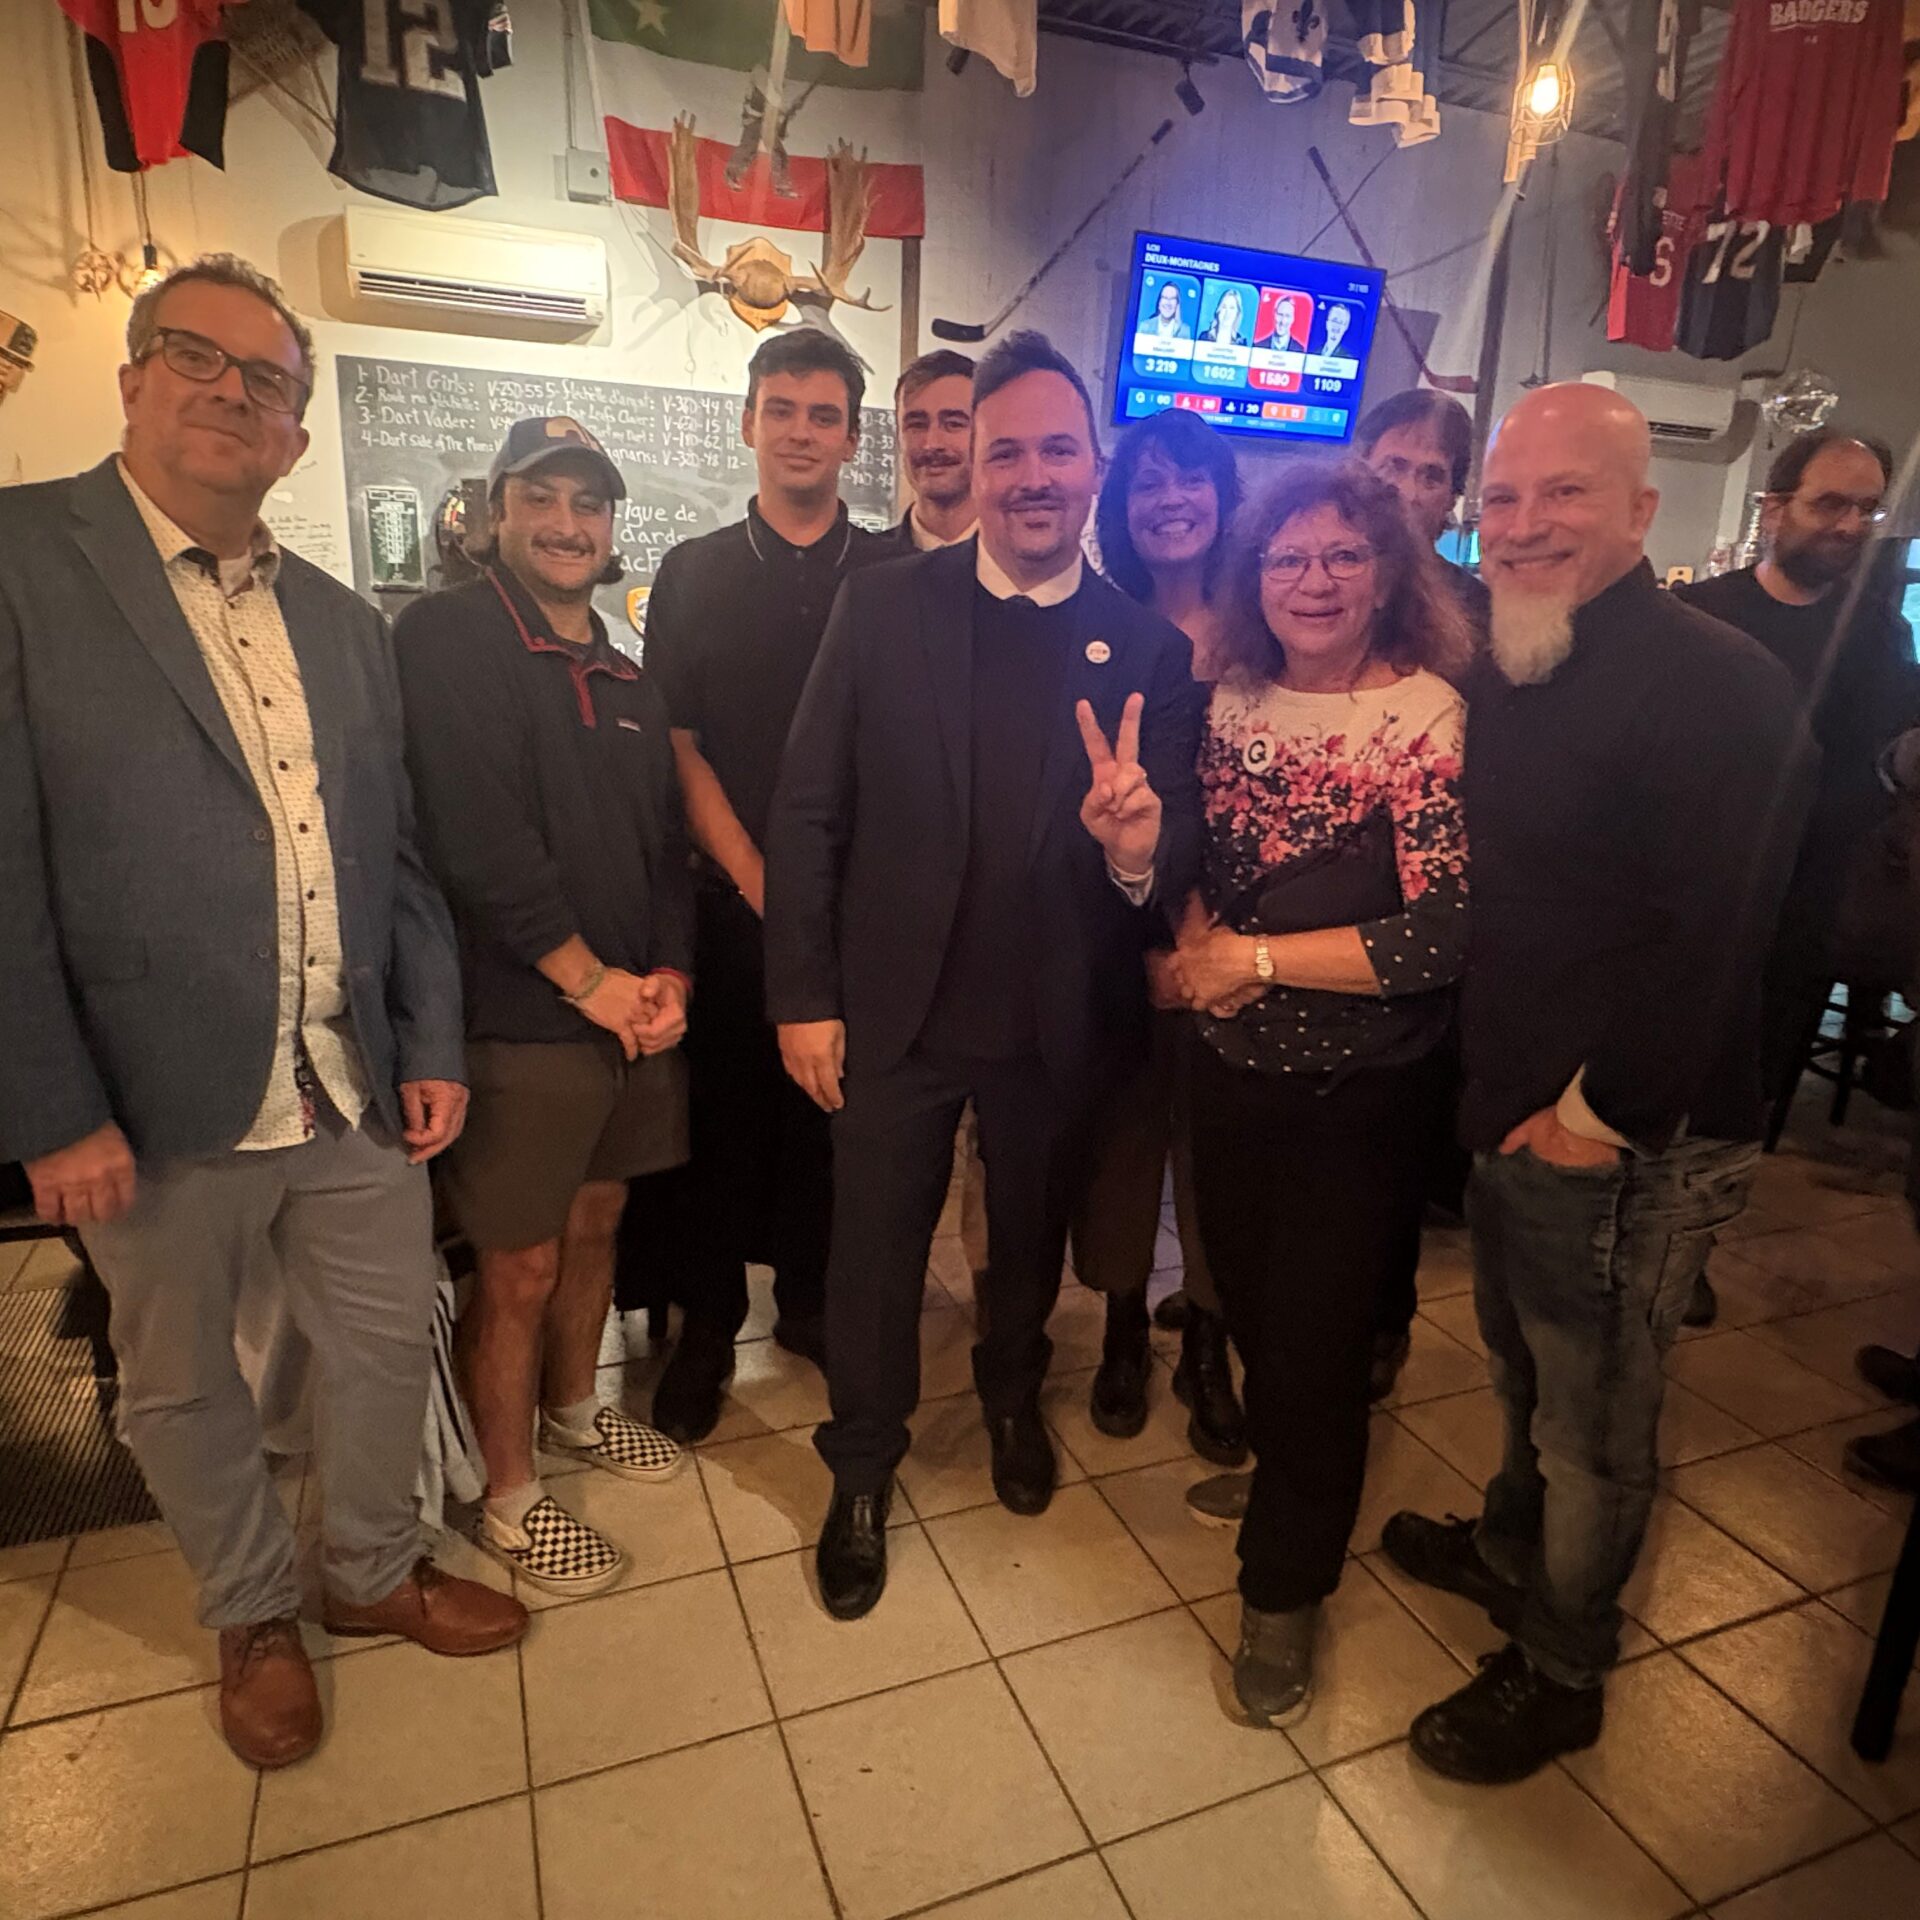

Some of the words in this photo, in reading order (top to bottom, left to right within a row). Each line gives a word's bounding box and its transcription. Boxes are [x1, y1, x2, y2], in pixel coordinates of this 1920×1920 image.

[1770, 0, 1868, 25] BADGERS
[360, 0, 467, 101] 12
[1144, 252, 1220, 272] DEUX-MONTAGNES
[1702, 219, 1770, 285] 72
[376, 364, 418, 389] Dart
[380, 405, 420, 425] Dart
[422, 409, 476, 430] Vader:
[380, 430, 407, 447] Dart
[674, 503, 698, 523] de
